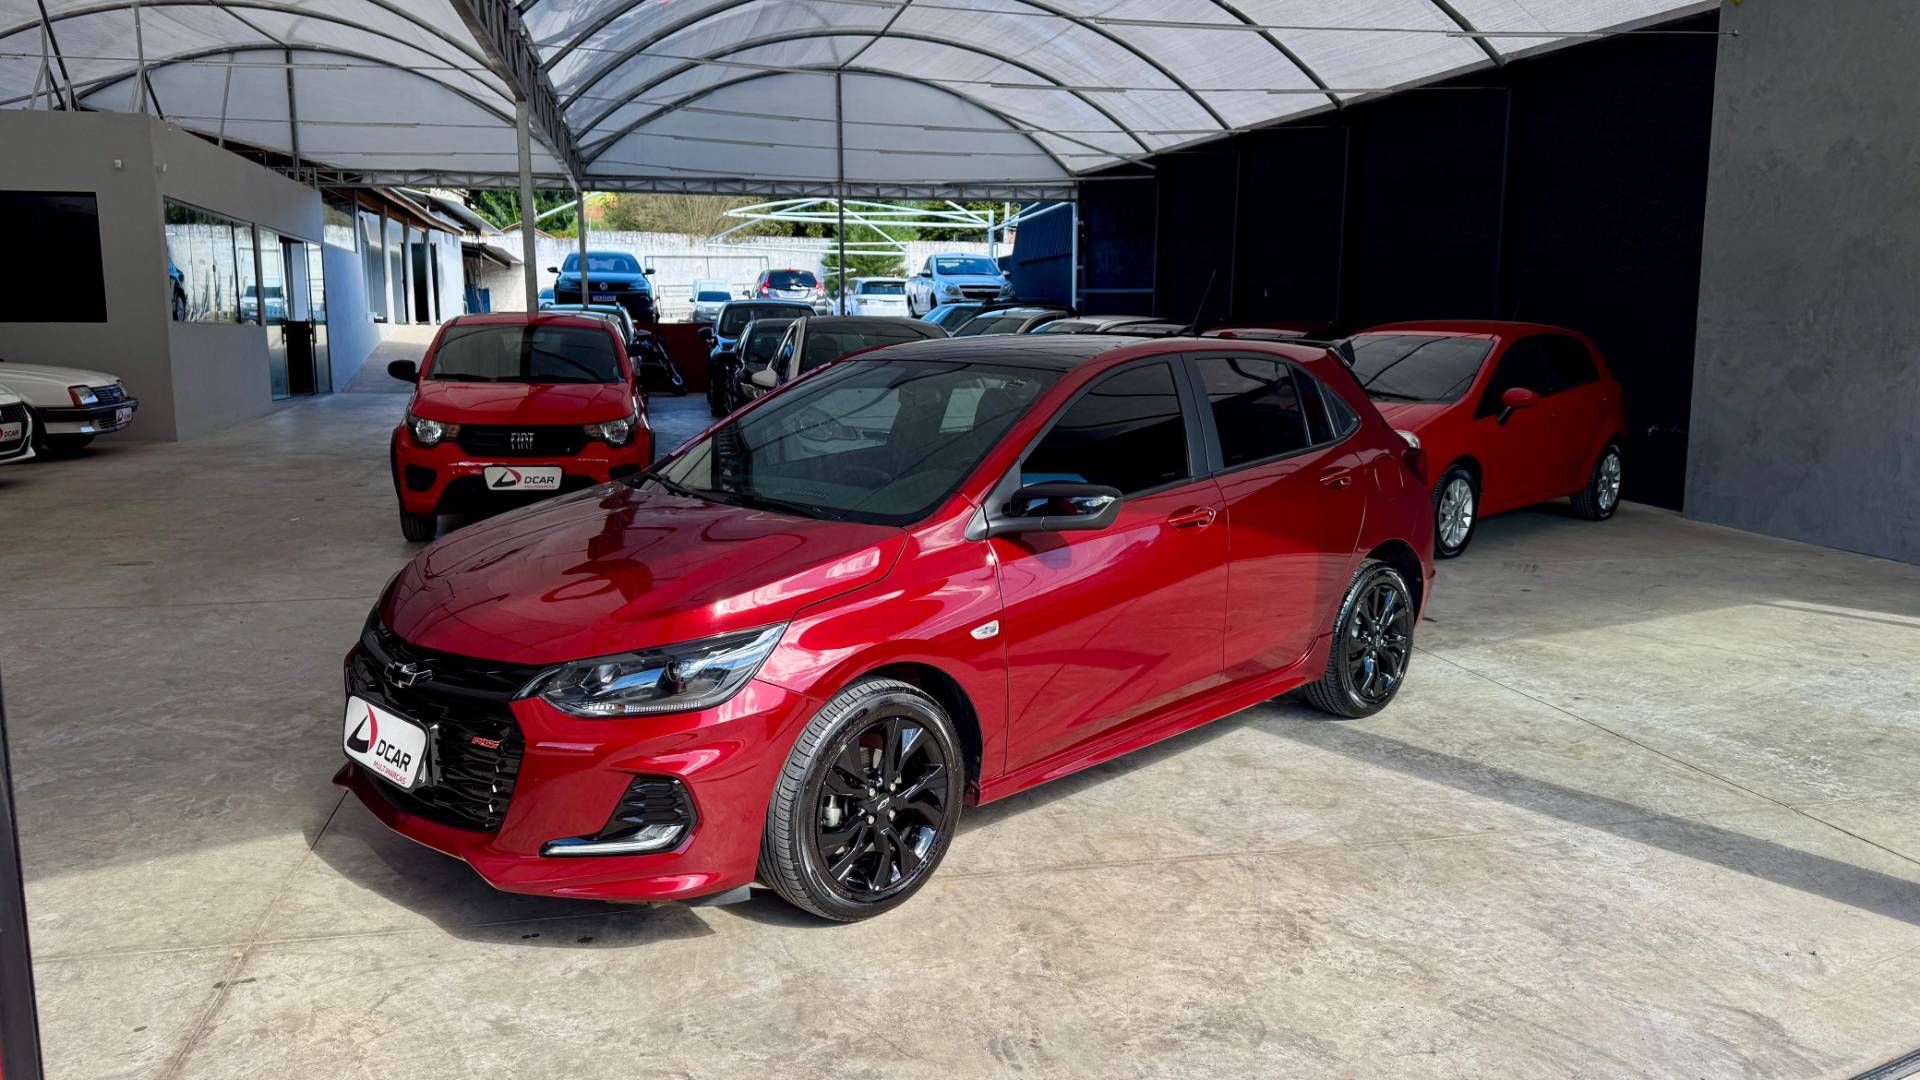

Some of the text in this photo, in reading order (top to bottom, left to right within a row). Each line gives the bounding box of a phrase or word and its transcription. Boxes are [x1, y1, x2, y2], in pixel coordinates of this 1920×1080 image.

[511, 432, 535, 450] FIAT
[524, 476, 555, 484] DCAR
[376, 739, 411, 772] DCAR
[373, 760, 407, 785] MULTIMARCAS
